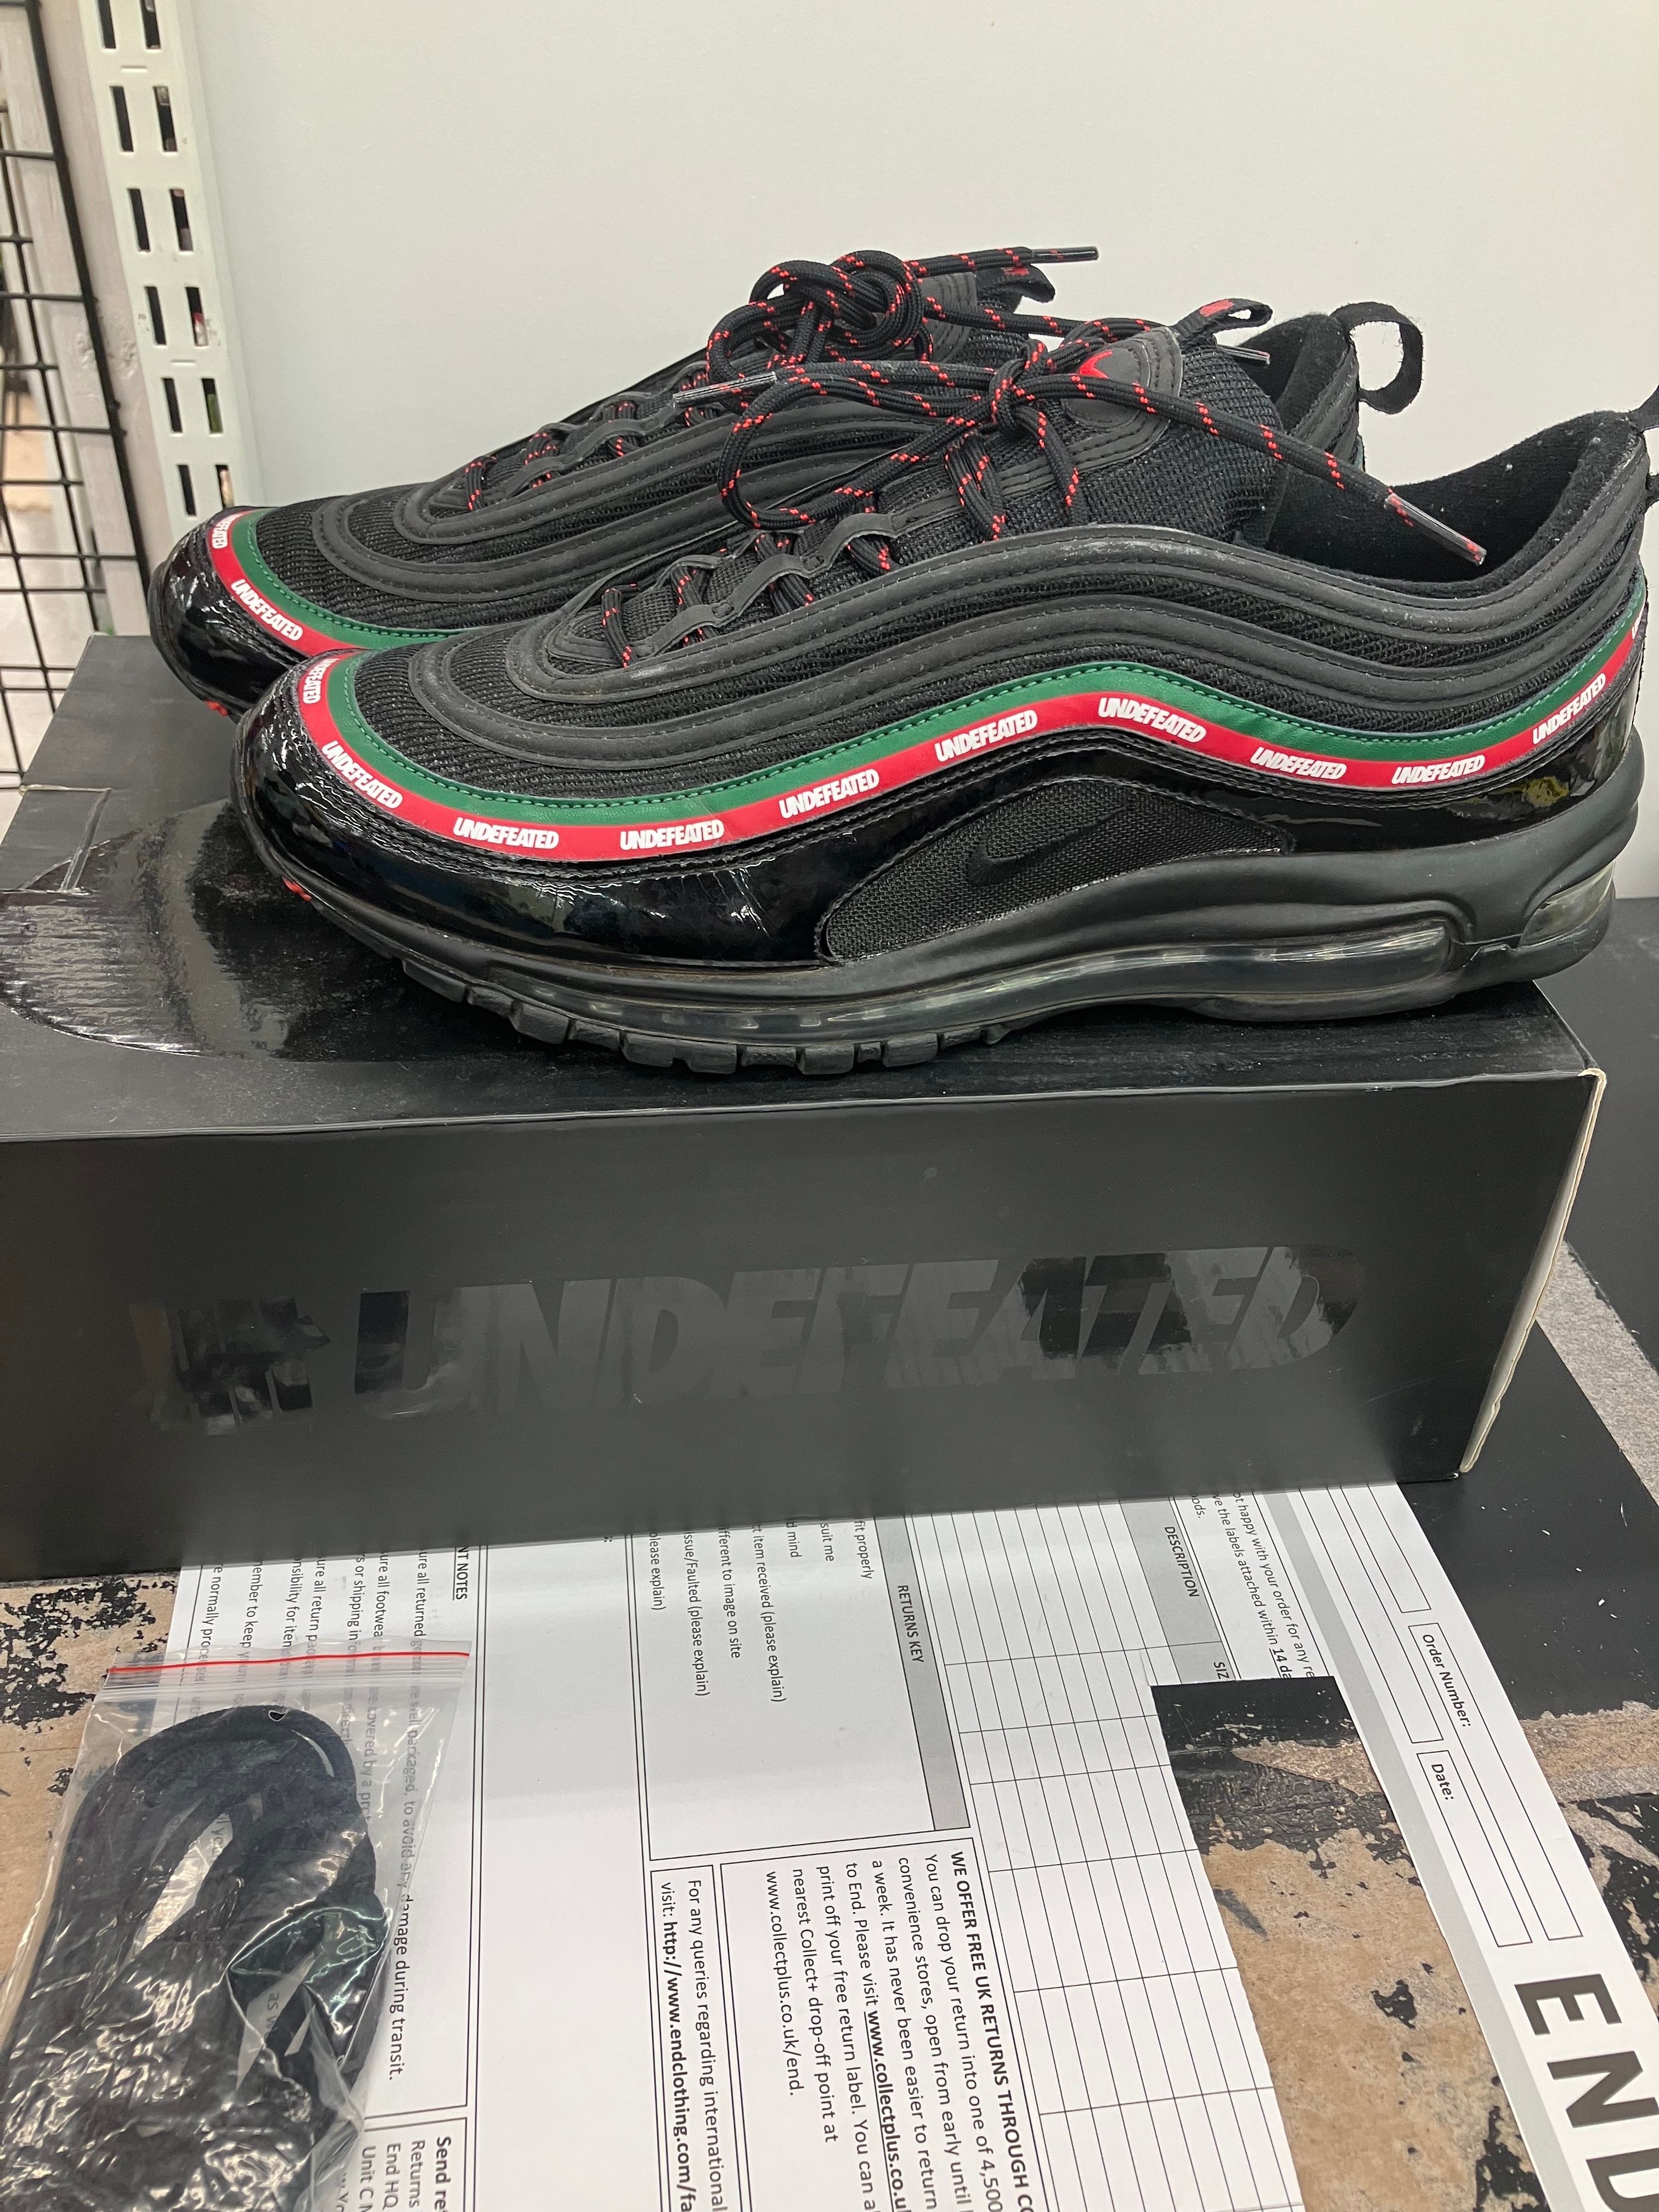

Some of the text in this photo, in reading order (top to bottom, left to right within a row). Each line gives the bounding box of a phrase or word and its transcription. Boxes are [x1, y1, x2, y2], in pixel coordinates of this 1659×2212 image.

[231, 579, 303, 641] UNDEFEATED
[1098, 697, 1206, 743] UNDEFEATED
[1532, 673, 1606, 745] UNDEFEATED
[934, 710, 1038, 762] UNDEFEATED
[321, 741, 403, 809] UNDEFEATED
[1250, 747, 1347, 780] UNDEFEATED
[1391, 755, 1486, 785] UNDEFEATED
[778, 769, 879, 819] UNDEFEATED
[453, 817, 560, 849] UNDEFEATED
[620, 819, 724, 851] UNDEFEATED
[354, 1244, 1365, 1418] UNDEFEATED
[1237, 1505, 1257, 1536] happy
[750, 1536, 765, 1559] item
[787, 1531, 802, 1558] mind
[820, 1523, 834, 1561] suit me
[854, 1520, 875, 1579] fit properly
[1164, 1526, 1200, 1598] DESCRIPTION
[1251, 1538, 1269, 1561] with
[313, 1580, 327, 1593] all
[354, 1566, 364, 1578] or
[377, 1575, 391, 1588] all
[416, 1572, 430, 1584] all
[455, 1563, 469, 1600] NOTES
[649, 1567, 667, 1611] explain)
[722, 1568, 733, 1581] to
[756, 1562, 775, 1609] received
[1217, 1508, 1231, 1525] the
[1224, 1528, 1245, 1558] labels
[1238, 1560, 1267, 1607] attached
[1257, 1610, 1278, 1645] within
[1272, 1648, 1287, 1662] 14
[1259, 1563, 1279, 1588] your
[202, 1576, 221, 1625] normally
[246, 1606, 258, 1618] to
[285, 1606, 300, 1622] for
[309, 1595, 323, 1631] return
[347, 1580, 366, 1627] shipping
[374, 1590, 389, 1638] footwea
[414, 1587, 427, 1637] returned
[722, 1583, 737, 1618] image
[1273, 1590, 1293, 1621] order
[239, 1621, 258, 1648] keep
[687, 1606, 703, 1648] (please
[727, 1620, 738, 1635] on
[760, 1611, 777, 1652] (please
[897, 1584, 925, 1663] RETURNS KEY
[1286, 1623, 1300, 1640] for
[728, 1637, 742, 1661] site
[1294, 1643, 1310, 1663] any
[690, 1647, 711, 1696] explain)
[764, 1655, 787, 1703] explain)
[1214, 1661, 1229, 1680] SIZ
[1422, 1634, 1471, 1727] Order Number:
[1431, 1764, 1454, 1800] Date:
[403, 1801, 415, 1815] to
[845, 1862, 858, 1878] to
[950, 1848, 967, 1877] WE
[848, 1882, 866, 1915] End.
[956, 1880, 978, 1929] OFFER
[854, 1919, 871, 1969] Please
[966, 1933, 986, 1972] FREE
[389, 1960, 410, 2014] during
[766, 1871, 805, 2096] www.collectplus.co.uk/end.
[862, 1973, 879, 2007] visit
[975, 1976, 992, 2000] UK
[792, 1869, 838, 2143] nearest Collect+ drop-off point at
[388, 2017, 405, 2081] transit.
[661, 1882, 696, 2212] visit: http://www.endclothing.com/fa
[688, 1880, 728, 2212] For any queries regarding international
[815, 1866, 876, 2212] print off your free return label. You can a
[872, 1860, 938, 2210] a week. It has never been easier to return
[898, 1857, 972, 2205] convenience stores, open from early until
[924, 1854, 1003, 2212] You can drop your return into one of 4,500
[980, 2004, 1009, 2086] RETURNS
[997, 2089, 1030, 2189] THROUGH
[359, 2145, 377, 2184] Unit
[382, 2142, 400, 2211] End HQ
[408, 2140, 426, 2208] Returns
[434, 2136, 451, 2212] Send re
[359, 2186, 374, 2200] C
